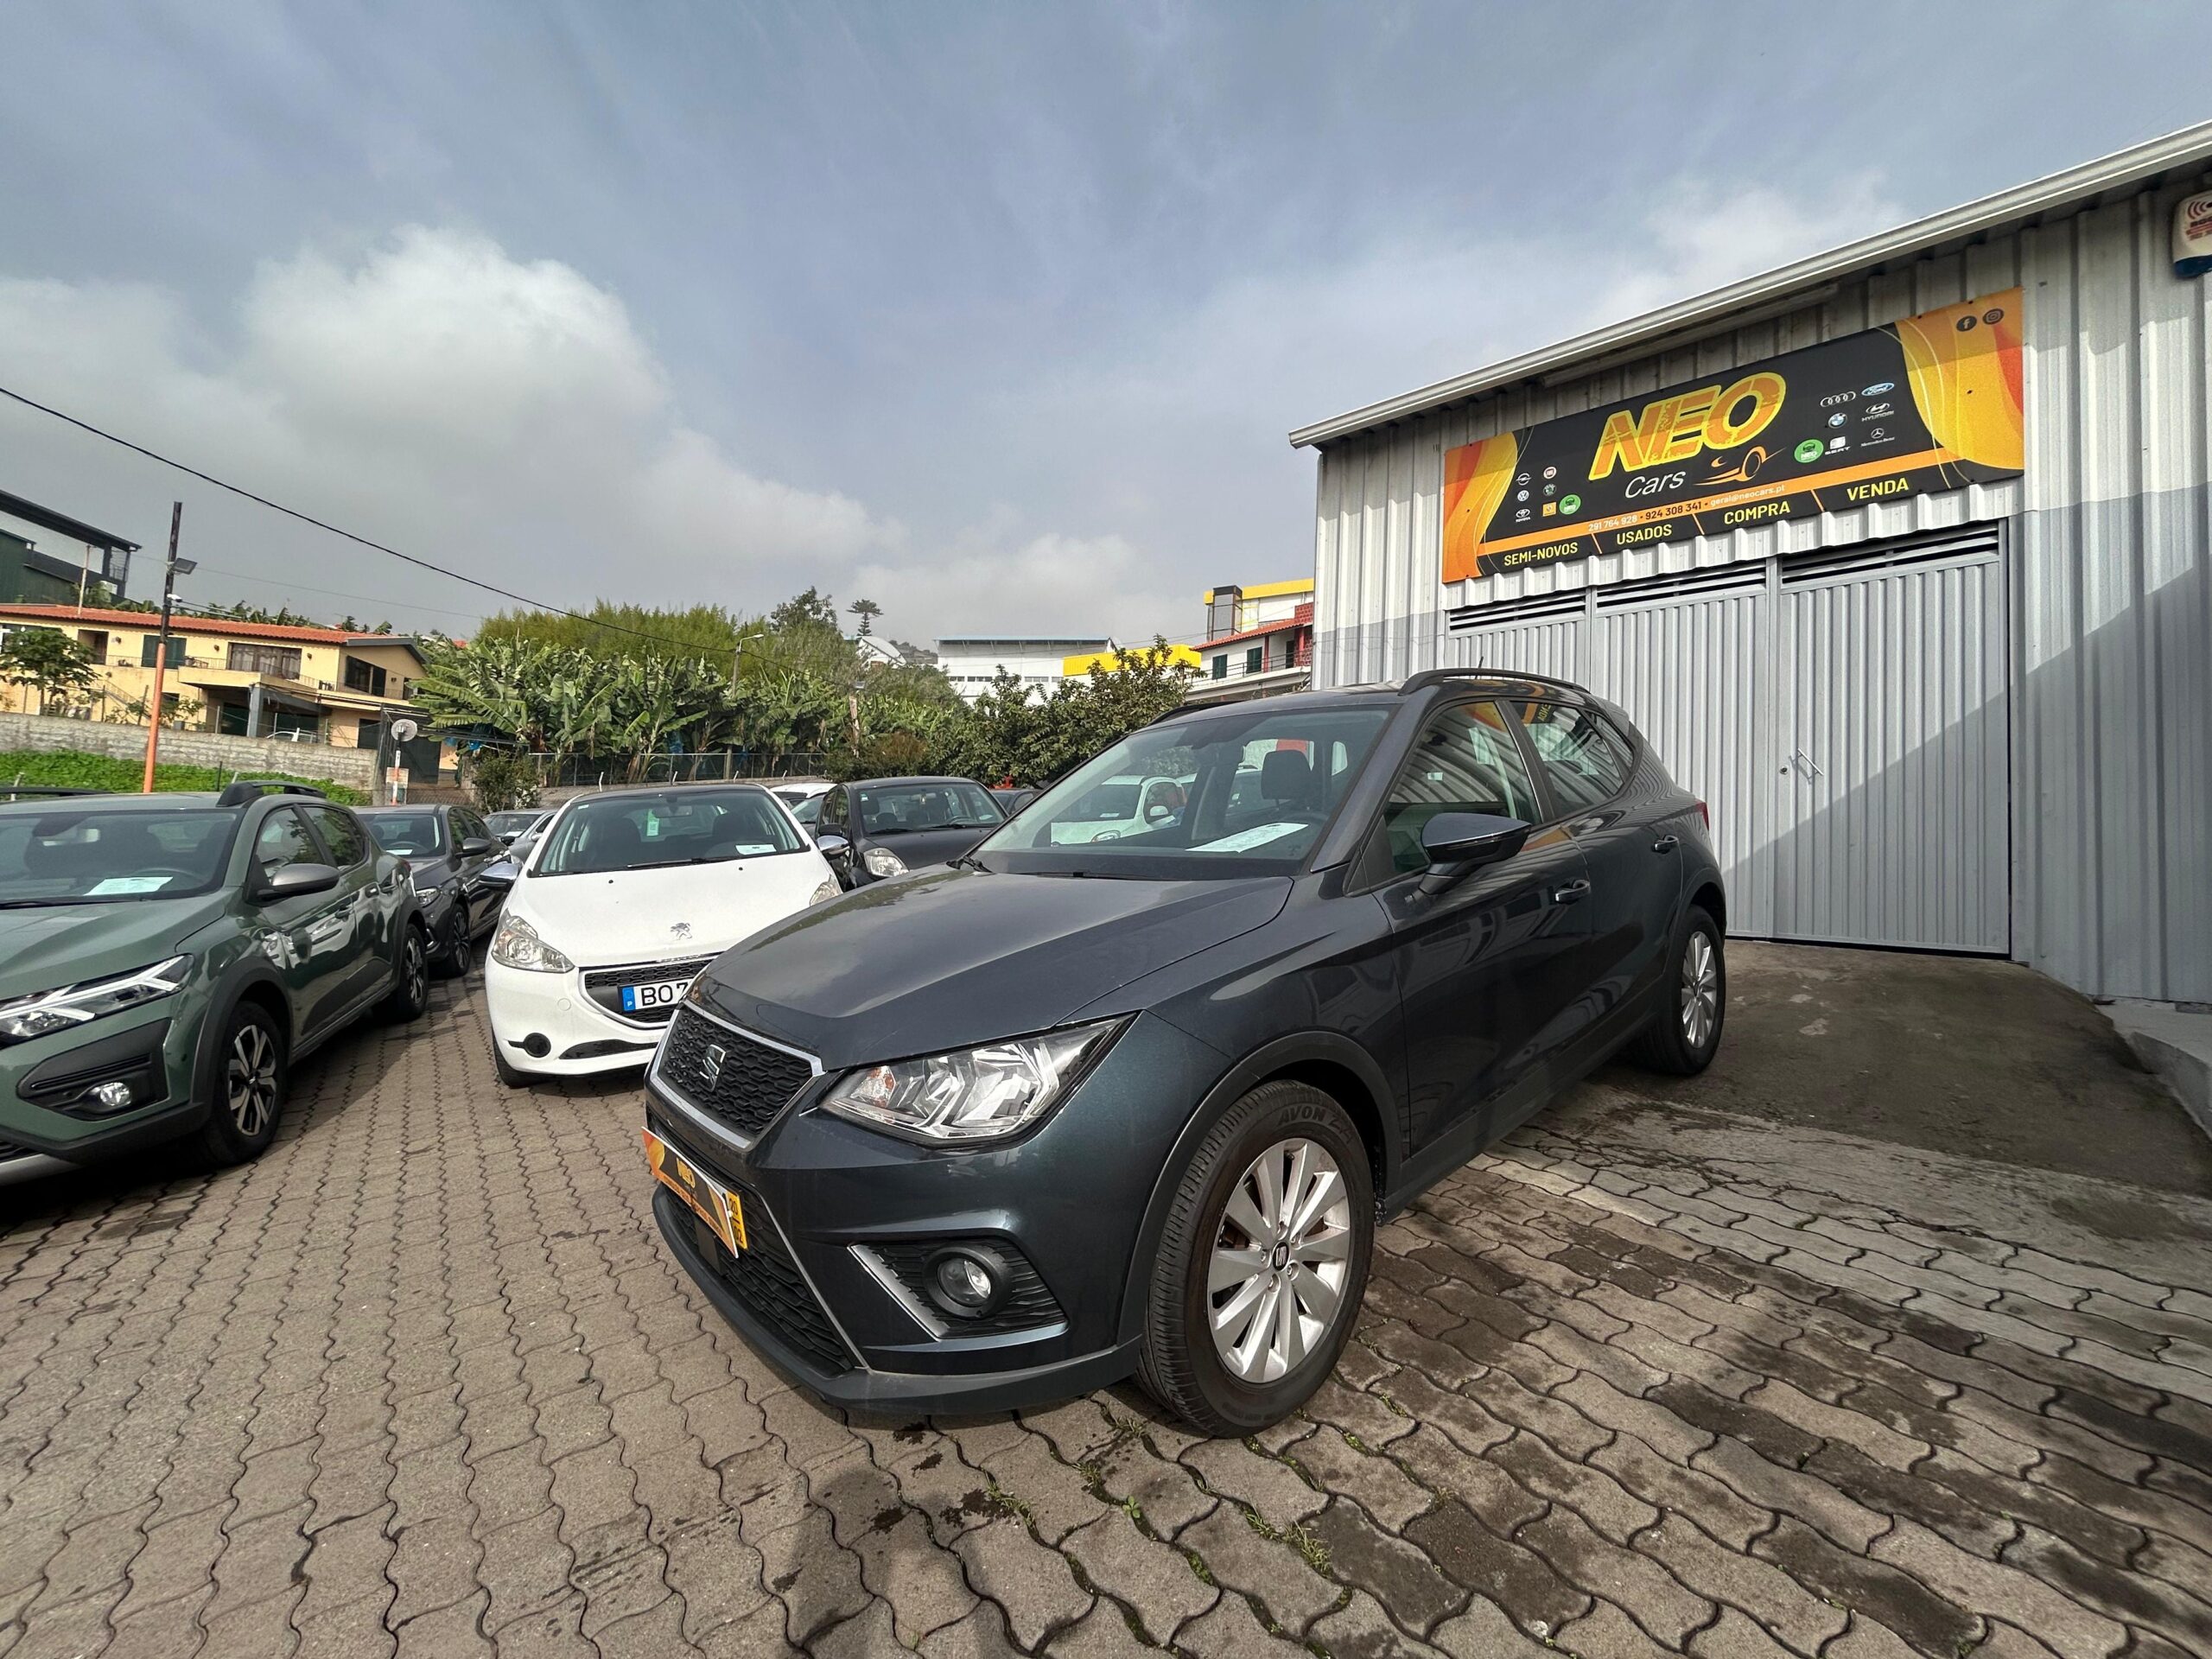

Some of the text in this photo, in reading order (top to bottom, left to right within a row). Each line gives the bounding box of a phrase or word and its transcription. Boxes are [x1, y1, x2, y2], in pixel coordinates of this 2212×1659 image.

[1588, 372, 1787, 480] NEO
[1825, 446, 1851, 455] SEAT
[1624, 471, 1686, 499] Cars
[1847, 477, 1910, 501] VENDA
[1588, 485, 1786, 532] 291 764 928 924 308 341 geral@neocars.pt
[1724, 500, 1791, 524] COMPRA
[1617, 524, 1672, 545] USADOS
[1503, 541, 1579, 566] SEMI-NOVOS
[640, 985, 673, 1007] BO
[1279, 1106, 1325, 1124] AVON
